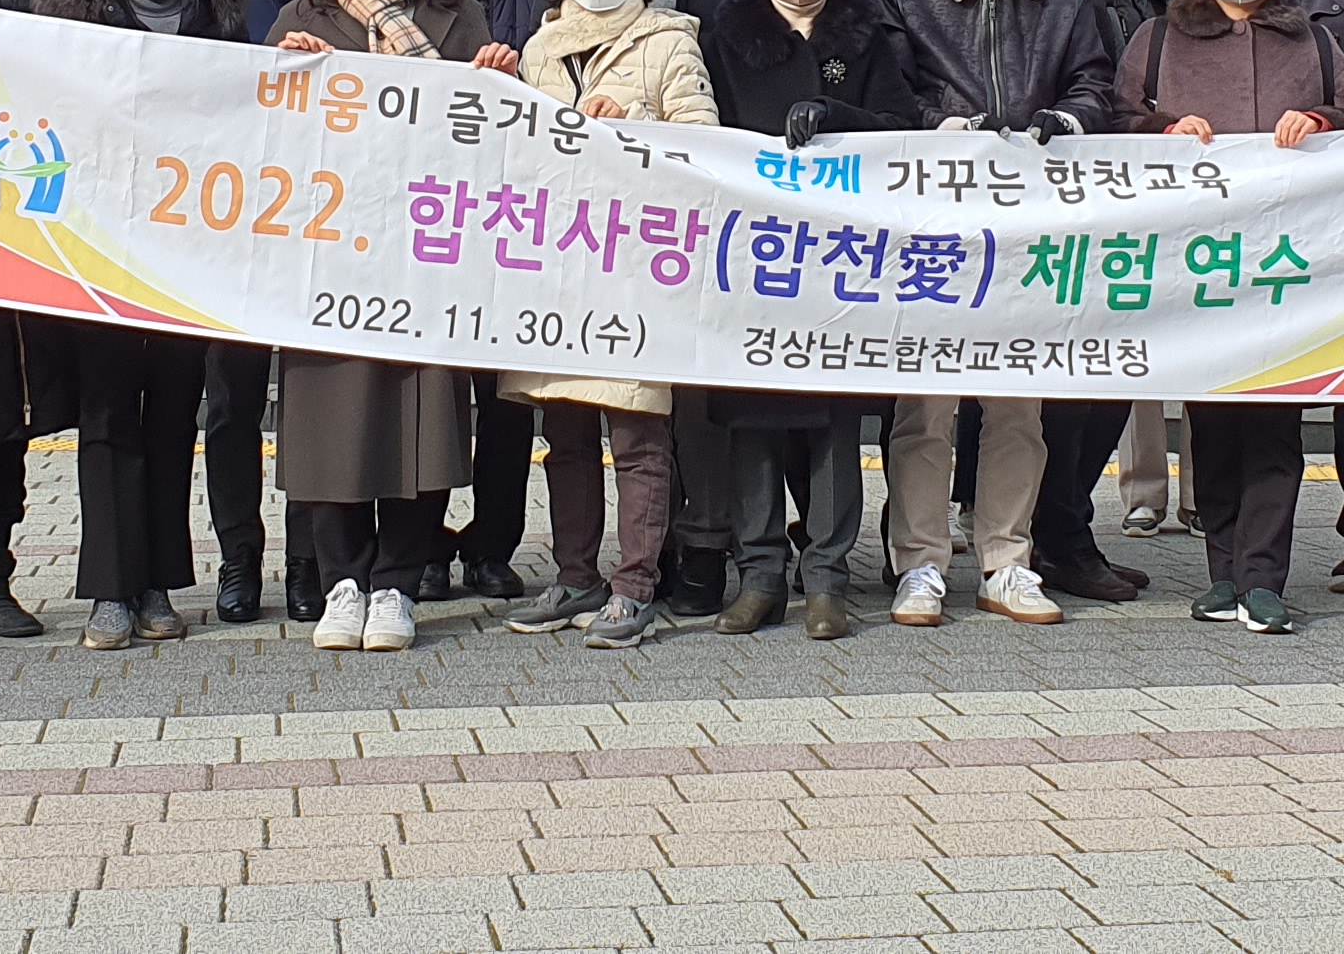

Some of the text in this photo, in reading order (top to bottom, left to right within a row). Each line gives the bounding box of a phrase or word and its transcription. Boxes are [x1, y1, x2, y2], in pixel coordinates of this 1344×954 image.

[257, 71, 420, 133] 배움이
[446, 90, 590, 155] 즐거운
[754, 149, 1231, 206] 함께 가꾸는 합천교육
[149, 155, 369, 253] 2022.
[1021, 232, 1158, 312] 체험
[1186, 233, 1311, 309] 연수
[312, 291, 648, 359] 2022. 11. 30.(수)
[742, 325, 1150, 378] 경상남도합천교육지원청
